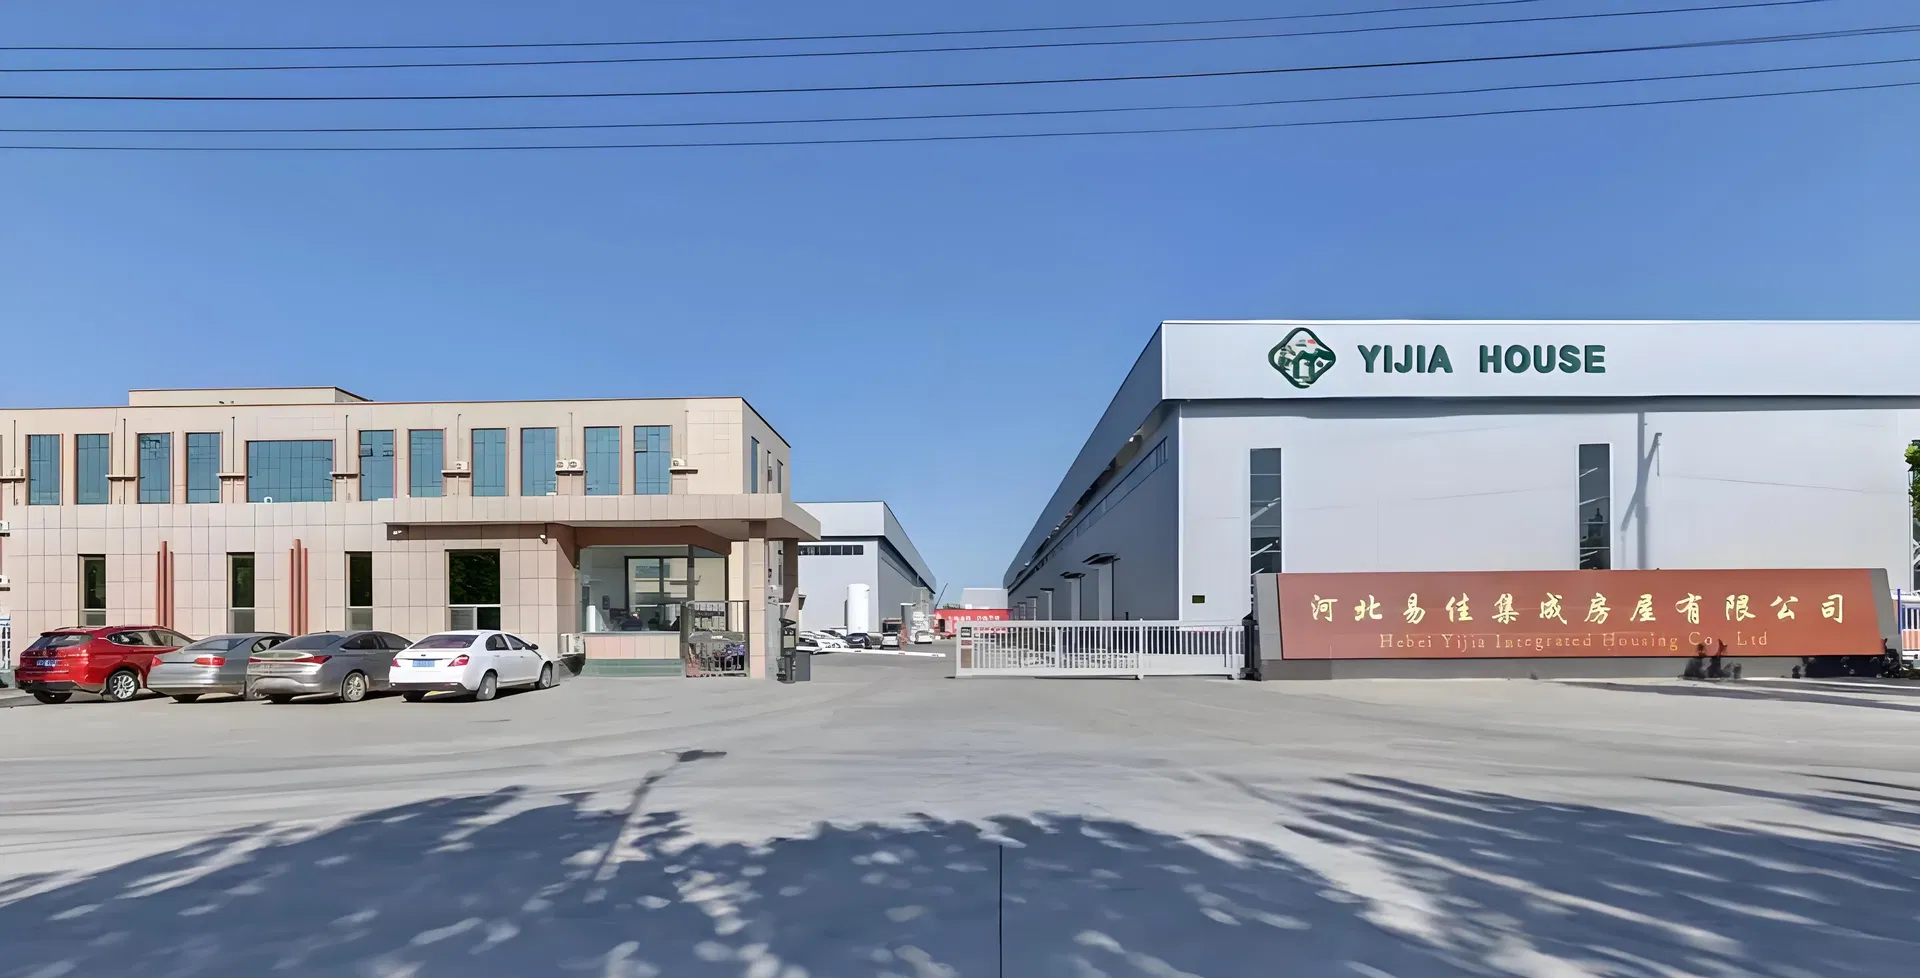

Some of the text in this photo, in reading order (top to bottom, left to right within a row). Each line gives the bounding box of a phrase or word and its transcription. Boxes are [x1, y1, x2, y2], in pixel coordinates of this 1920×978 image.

[1357, 344, 1606, 374] YIJIA HOUSE
[1310, 592, 1844, 625] 河北易佳集成房屋有限公司
[1379, 633, 1432, 648] Hebei
[1441, 633, 1485, 653] Yijia
[1495, 632, 1592, 651] Integrated
[1602, 631, 1678, 651] Housing
[1736, 630, 1768, 646] Ltd
